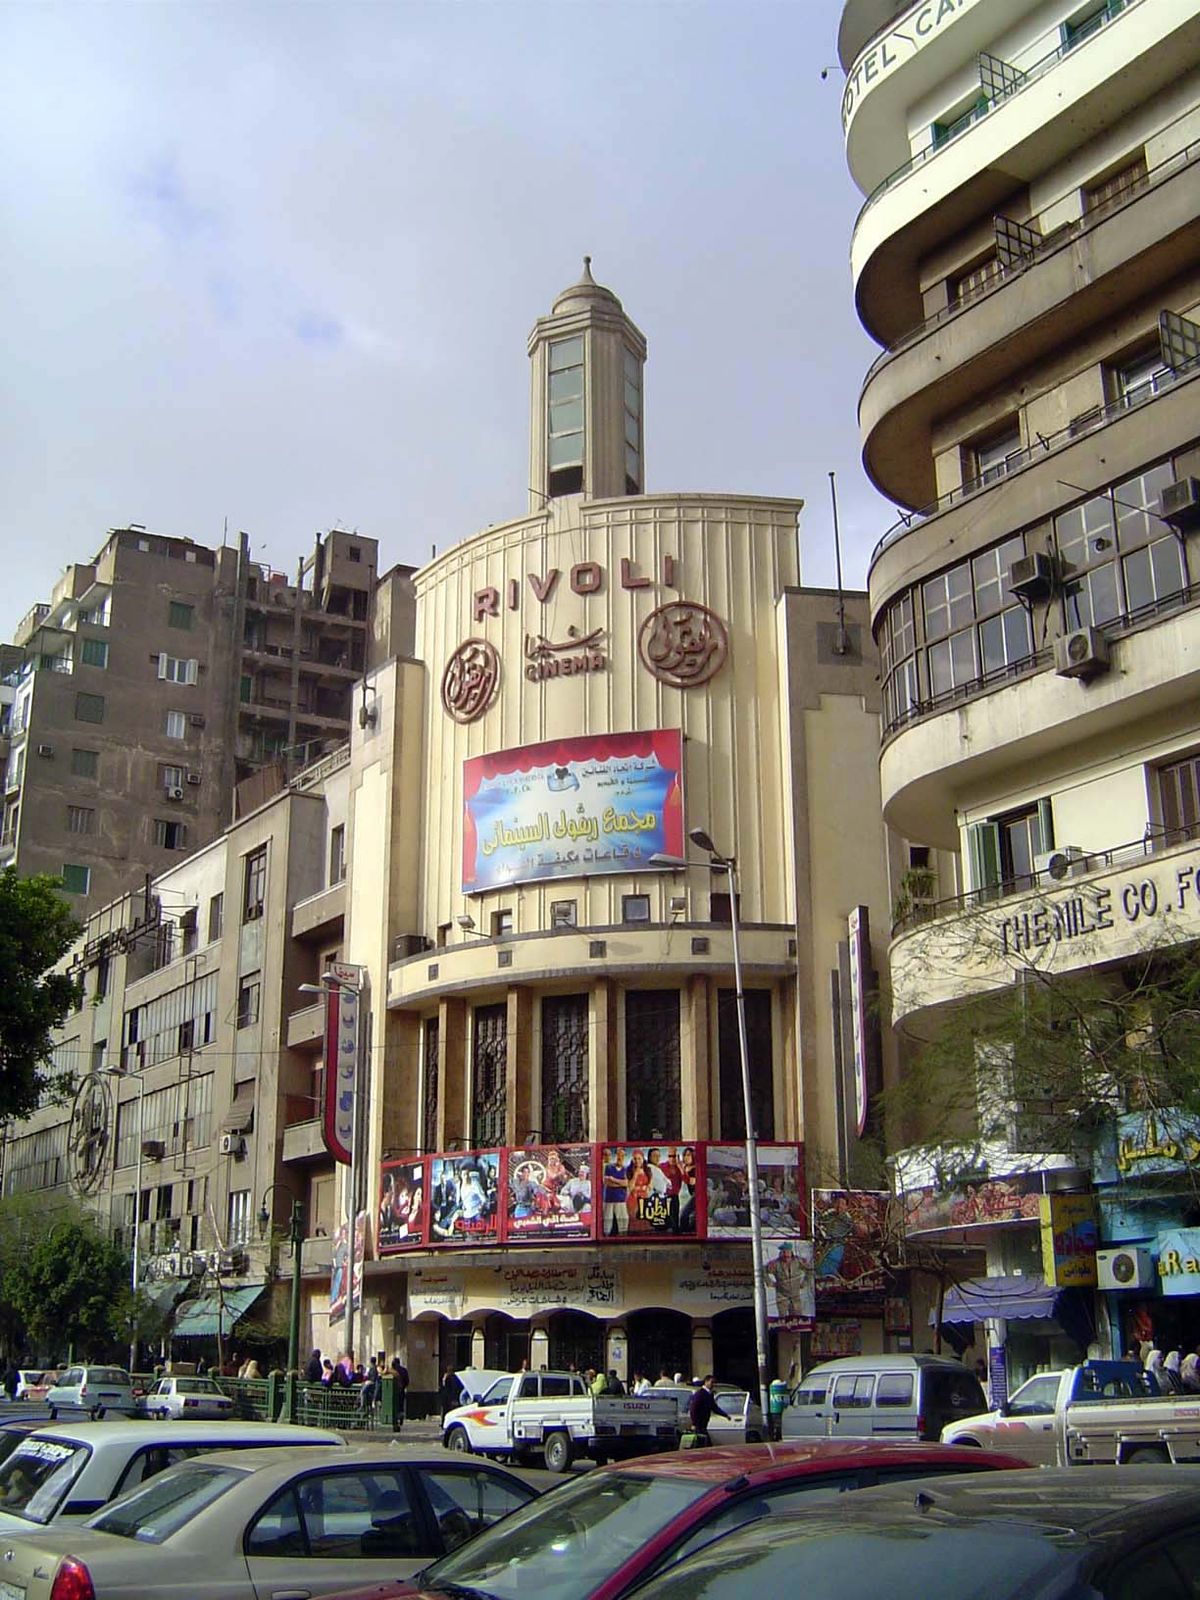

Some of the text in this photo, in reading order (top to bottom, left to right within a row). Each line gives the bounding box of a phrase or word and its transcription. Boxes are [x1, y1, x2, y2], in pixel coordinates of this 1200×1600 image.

[474, 555, 675, 623] RIVOLI
[525, 655, 605, 683] CINEMA
[996, 907, 1050, 955] THE
[1052, 888, 1114, 942] NILE
[1122, 878, 1172, 922] CO.
[623, 1402, 650, 1410] ISUZU
